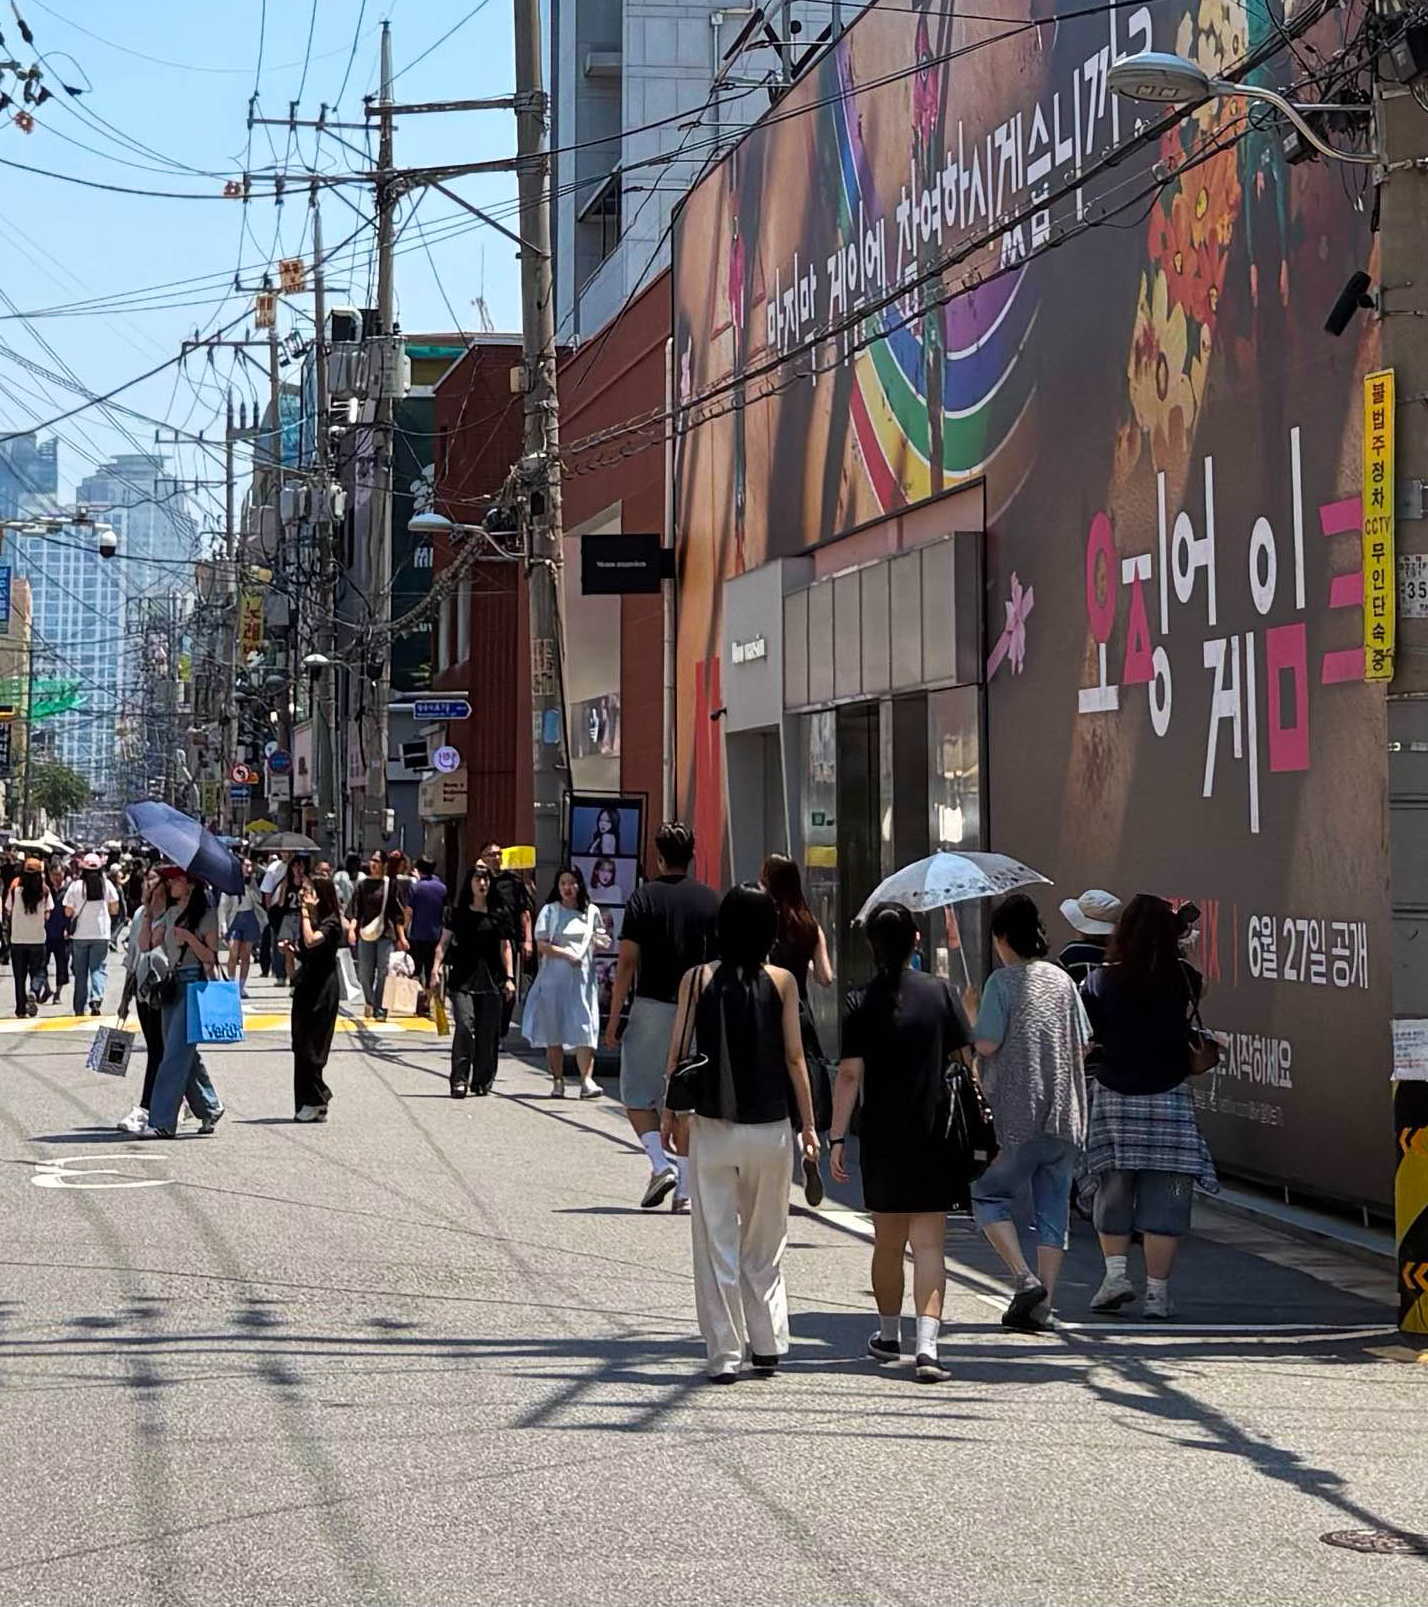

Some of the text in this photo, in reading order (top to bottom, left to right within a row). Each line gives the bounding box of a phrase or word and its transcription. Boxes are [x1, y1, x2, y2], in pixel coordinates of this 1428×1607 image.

[1371, 381, 1385, 509] 불법주정차
[1365, 516, 1391, 535] CCTV
[1079, 456, 1217, 737] 오징어
[1371, 543, 1385, 671] 무인단속중
[1248, 914, 1278, 979] 6월
[1283, 917, 1327, 985] 27일
[1331, 921, 1369, 990] 공개
